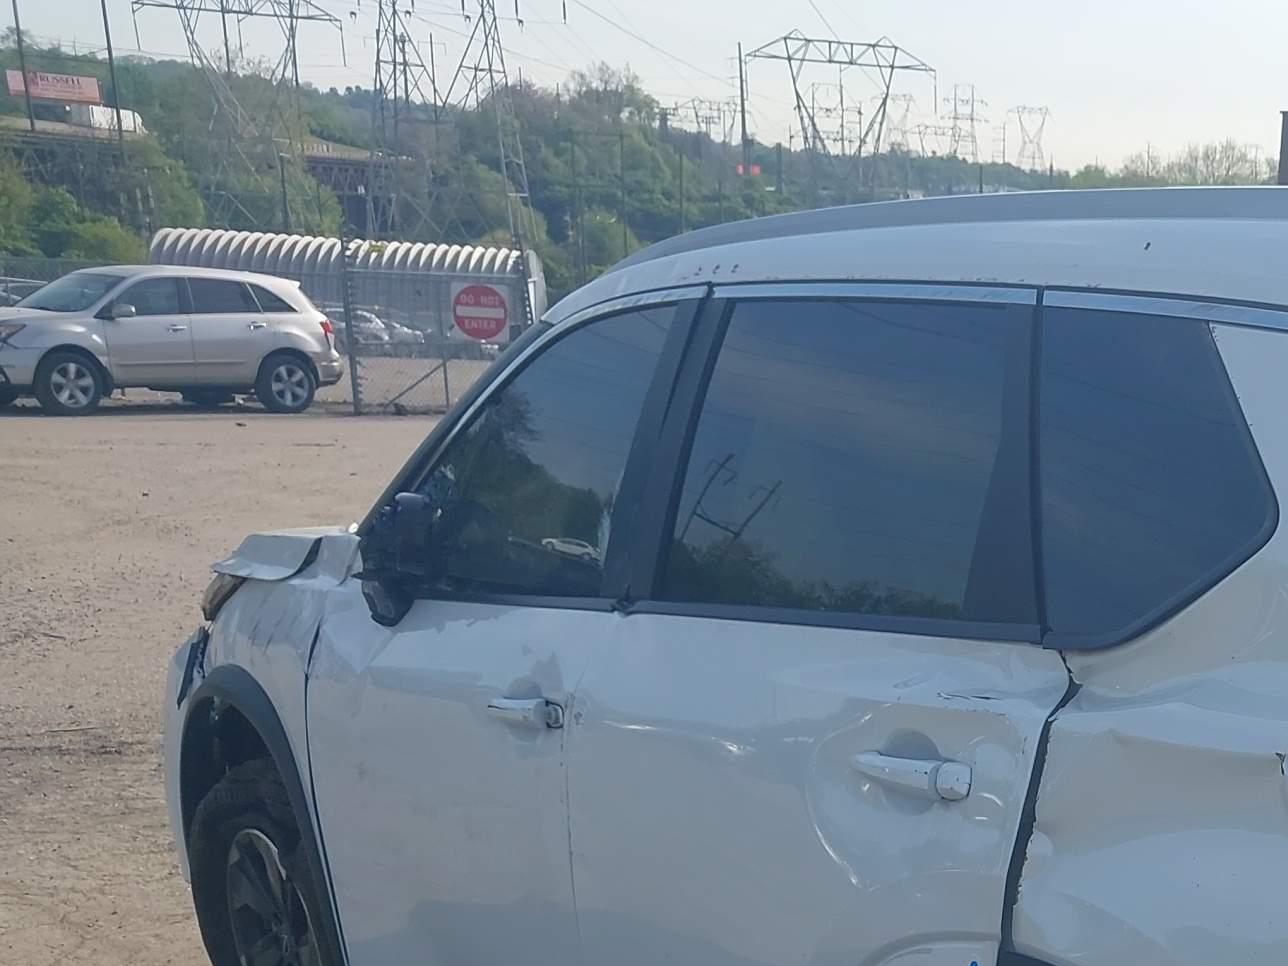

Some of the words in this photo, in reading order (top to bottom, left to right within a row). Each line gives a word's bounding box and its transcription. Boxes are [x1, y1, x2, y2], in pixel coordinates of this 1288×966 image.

[459, 294, 475, 304] DO
[480, 295, 499, 305] NOT
[464, 319, 497, 329] ENTER
